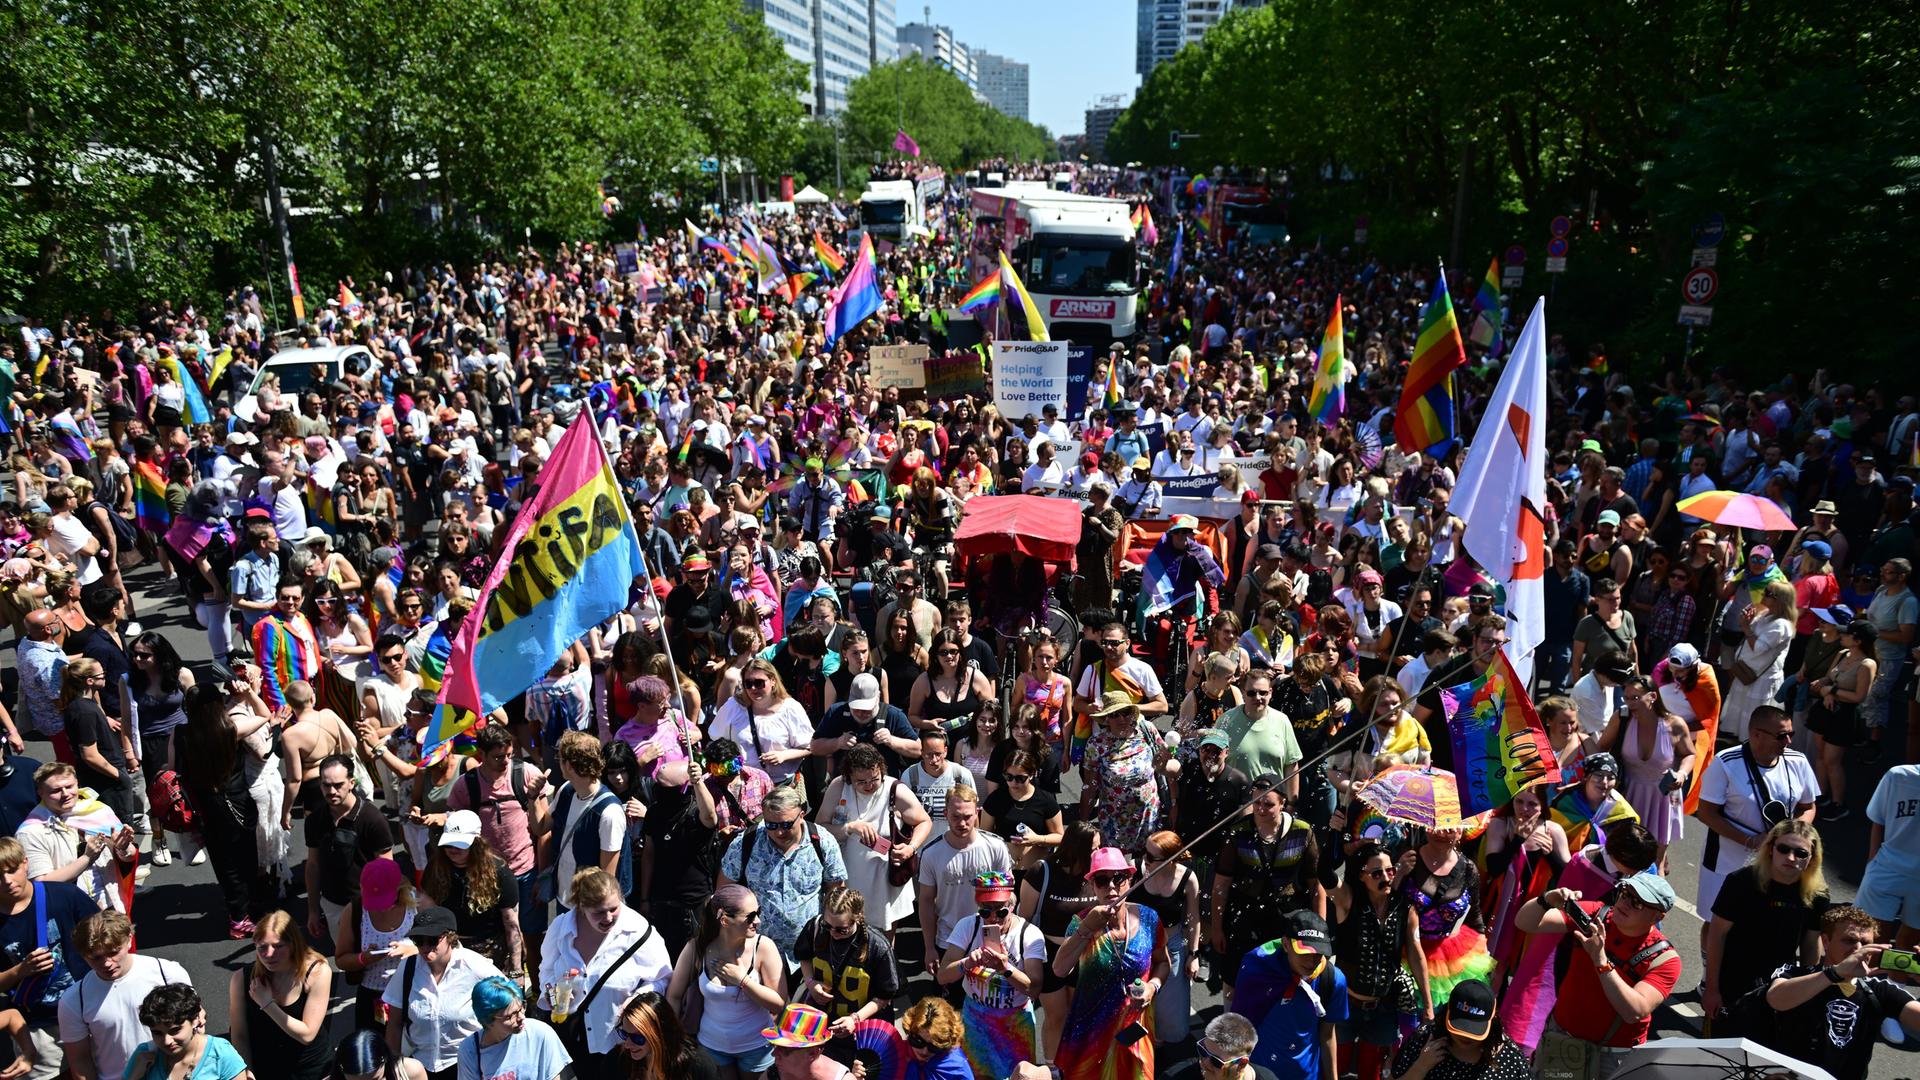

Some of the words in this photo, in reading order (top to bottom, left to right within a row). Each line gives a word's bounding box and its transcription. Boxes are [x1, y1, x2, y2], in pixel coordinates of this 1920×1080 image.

[1690, 277, 1710, 294] 30
[1054, 301, 1112, 316] ARNDT
[1014, 345, 1060, 355] Pride@SAP
[1001, 364, 1043, 377] Helping
[1001, 378, 1018, 388] the
[1021, 379, 1053, 388] World
[1001, 392, 1026, 401] Love
[1029, 392, 1061, 401] Better
[1895, 799, 1920, 818] RE
